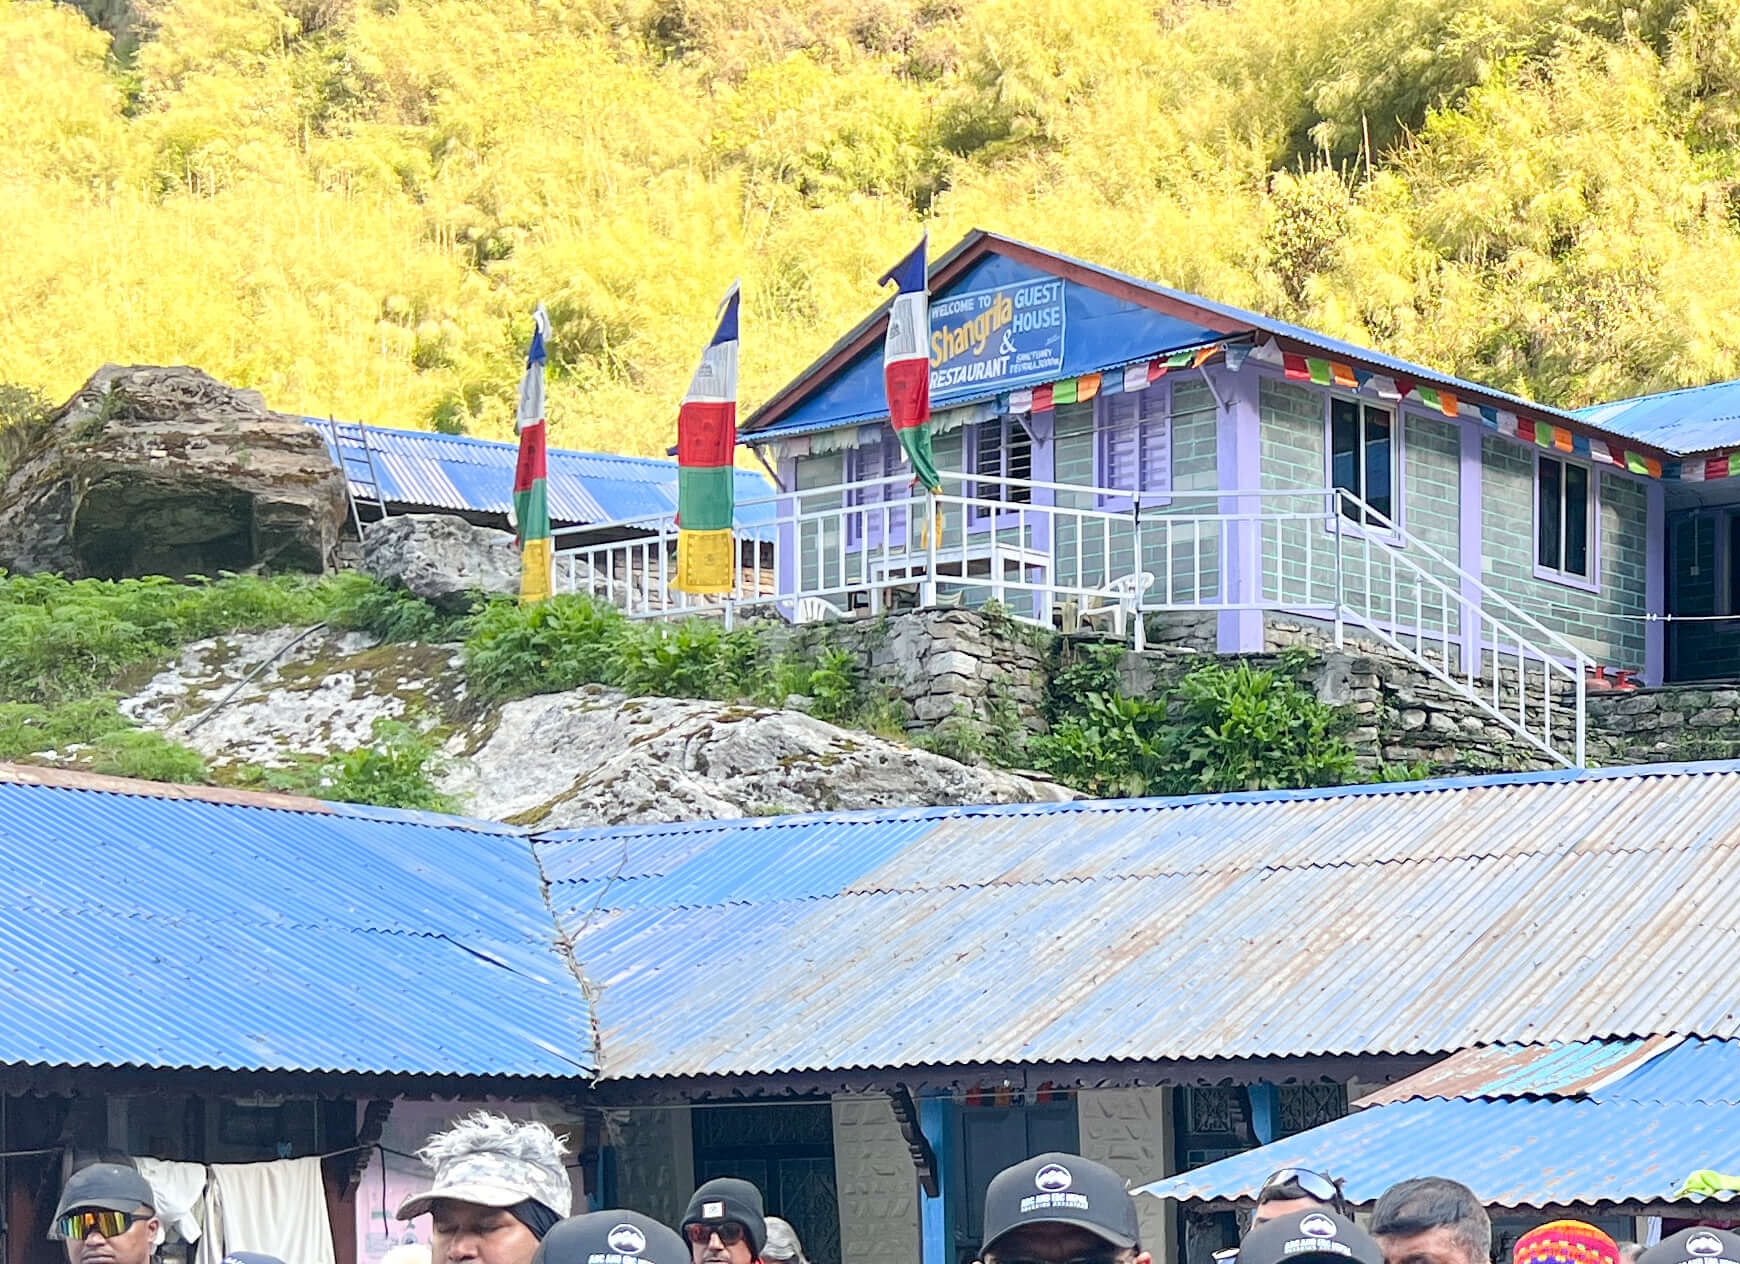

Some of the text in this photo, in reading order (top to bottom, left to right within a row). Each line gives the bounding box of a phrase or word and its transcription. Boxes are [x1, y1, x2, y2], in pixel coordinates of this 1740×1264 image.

[931, 295, 992, 319] WELCOME TO
[1014, 282, 1061, 309] GUEST
[1012, 307, 1061, 334] HOUSE
[999, 329, 1017, 355] &
[929, 355, 1011, 388] RESTAURANT
